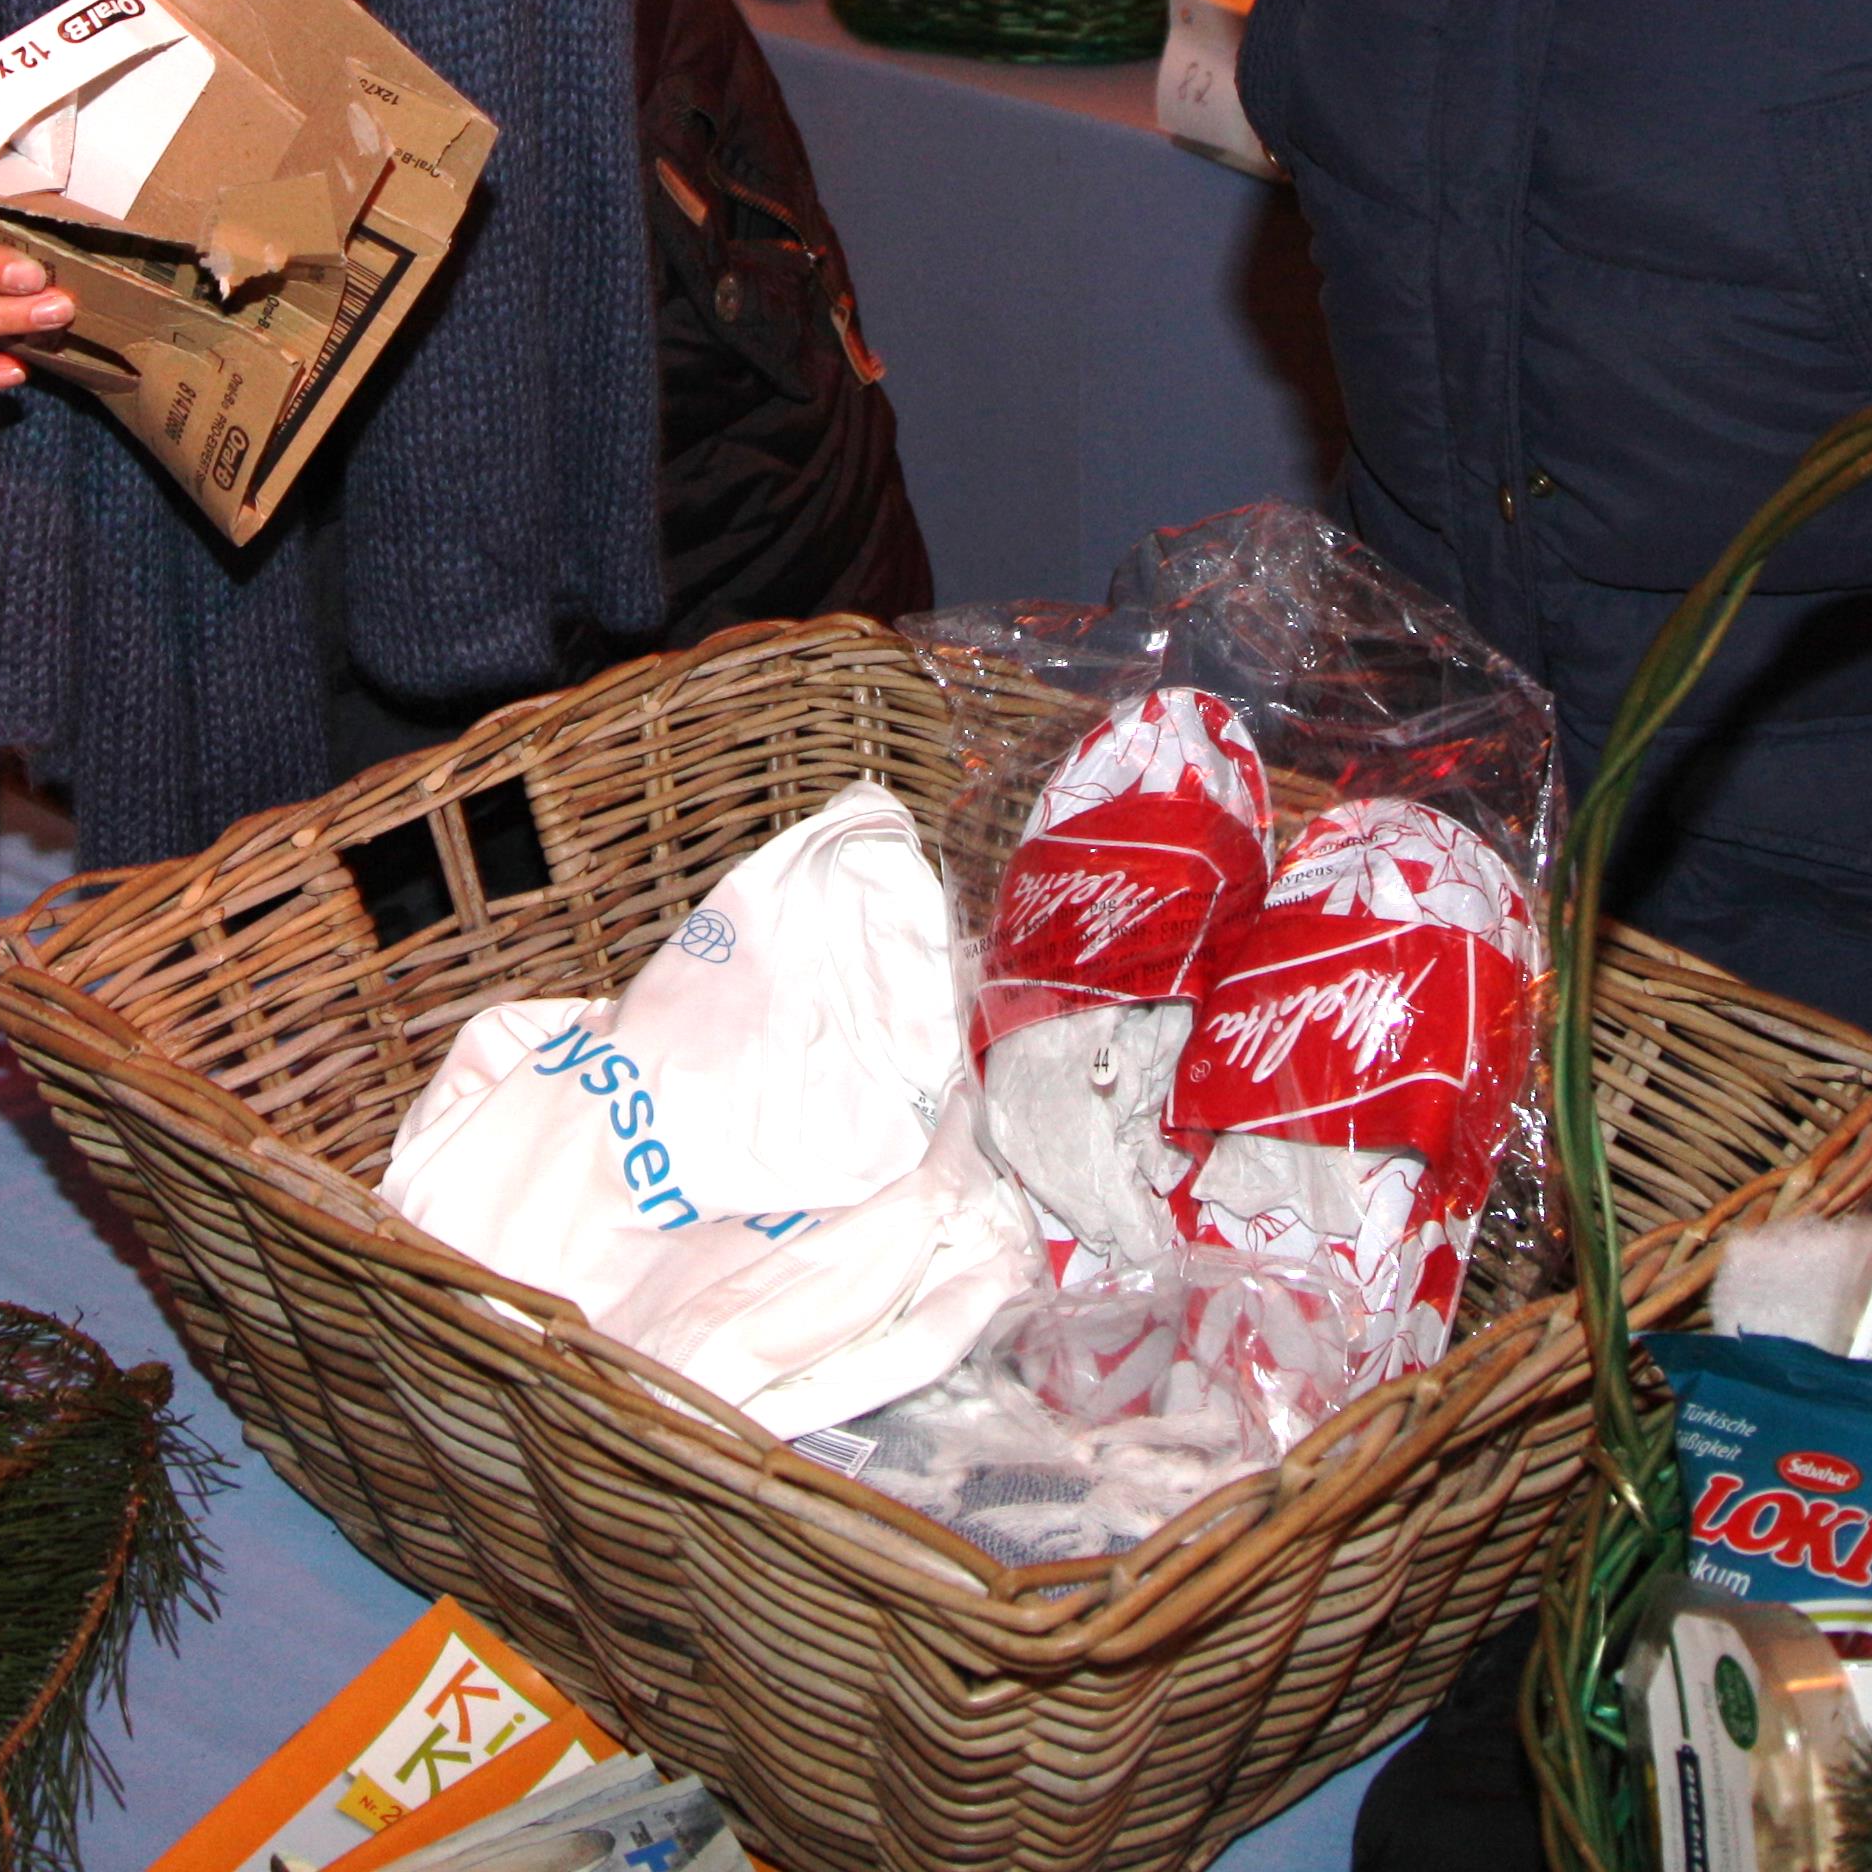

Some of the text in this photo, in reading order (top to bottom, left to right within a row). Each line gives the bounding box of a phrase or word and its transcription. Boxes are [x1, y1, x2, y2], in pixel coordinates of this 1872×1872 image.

[11, 40, 51, 69] 12
[1008, 869, 1191, 966] Melitta
[1206, 957, 1438, 1084] Melitta
[1093, 1047, 1110, 1073] 44
[1681, 1402, 1759, 1440] Türkische
[1787, 1457, 1852, 1488] Sebahat
[357, 1793, 388, 1820] Nr.
